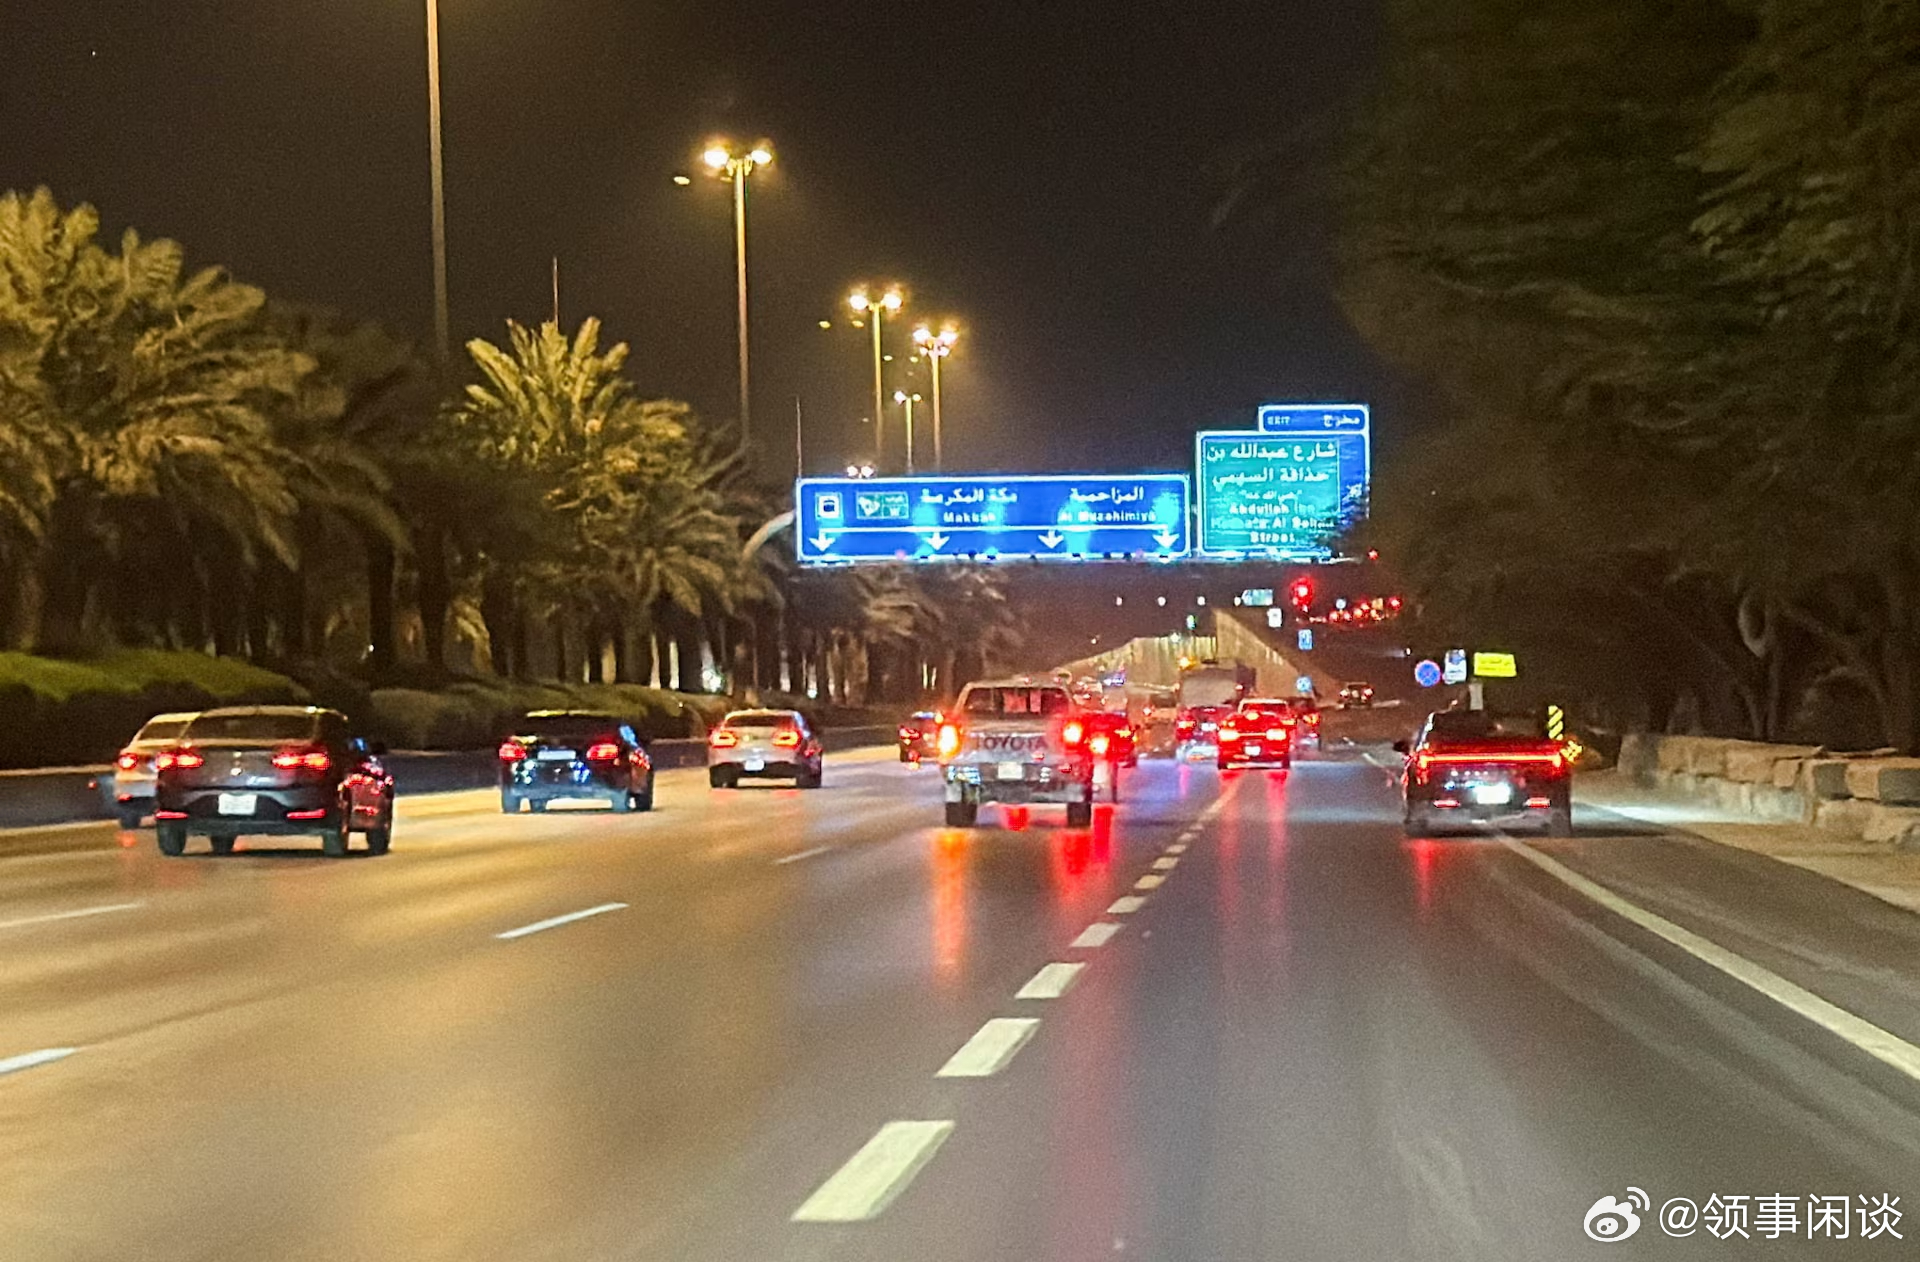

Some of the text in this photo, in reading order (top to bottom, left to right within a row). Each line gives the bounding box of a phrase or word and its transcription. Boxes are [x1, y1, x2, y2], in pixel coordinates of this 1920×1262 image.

[1267, 415, 1291, 426] EXIT
[1322, 414, 1361, 429] مخرج
[1206, 442, 1337, 462] شارع عبدالله بن
[921, 487, 985, 507] المكرمة
[987, 487, 1018, 503] مكة
[1069, 485, 1145, 505] المزاحمية
[943, 511, 996, 523] Makkah
[1249, 531, 1296, 543] Street
[969, 735, 1049, 751] TOYOTA
